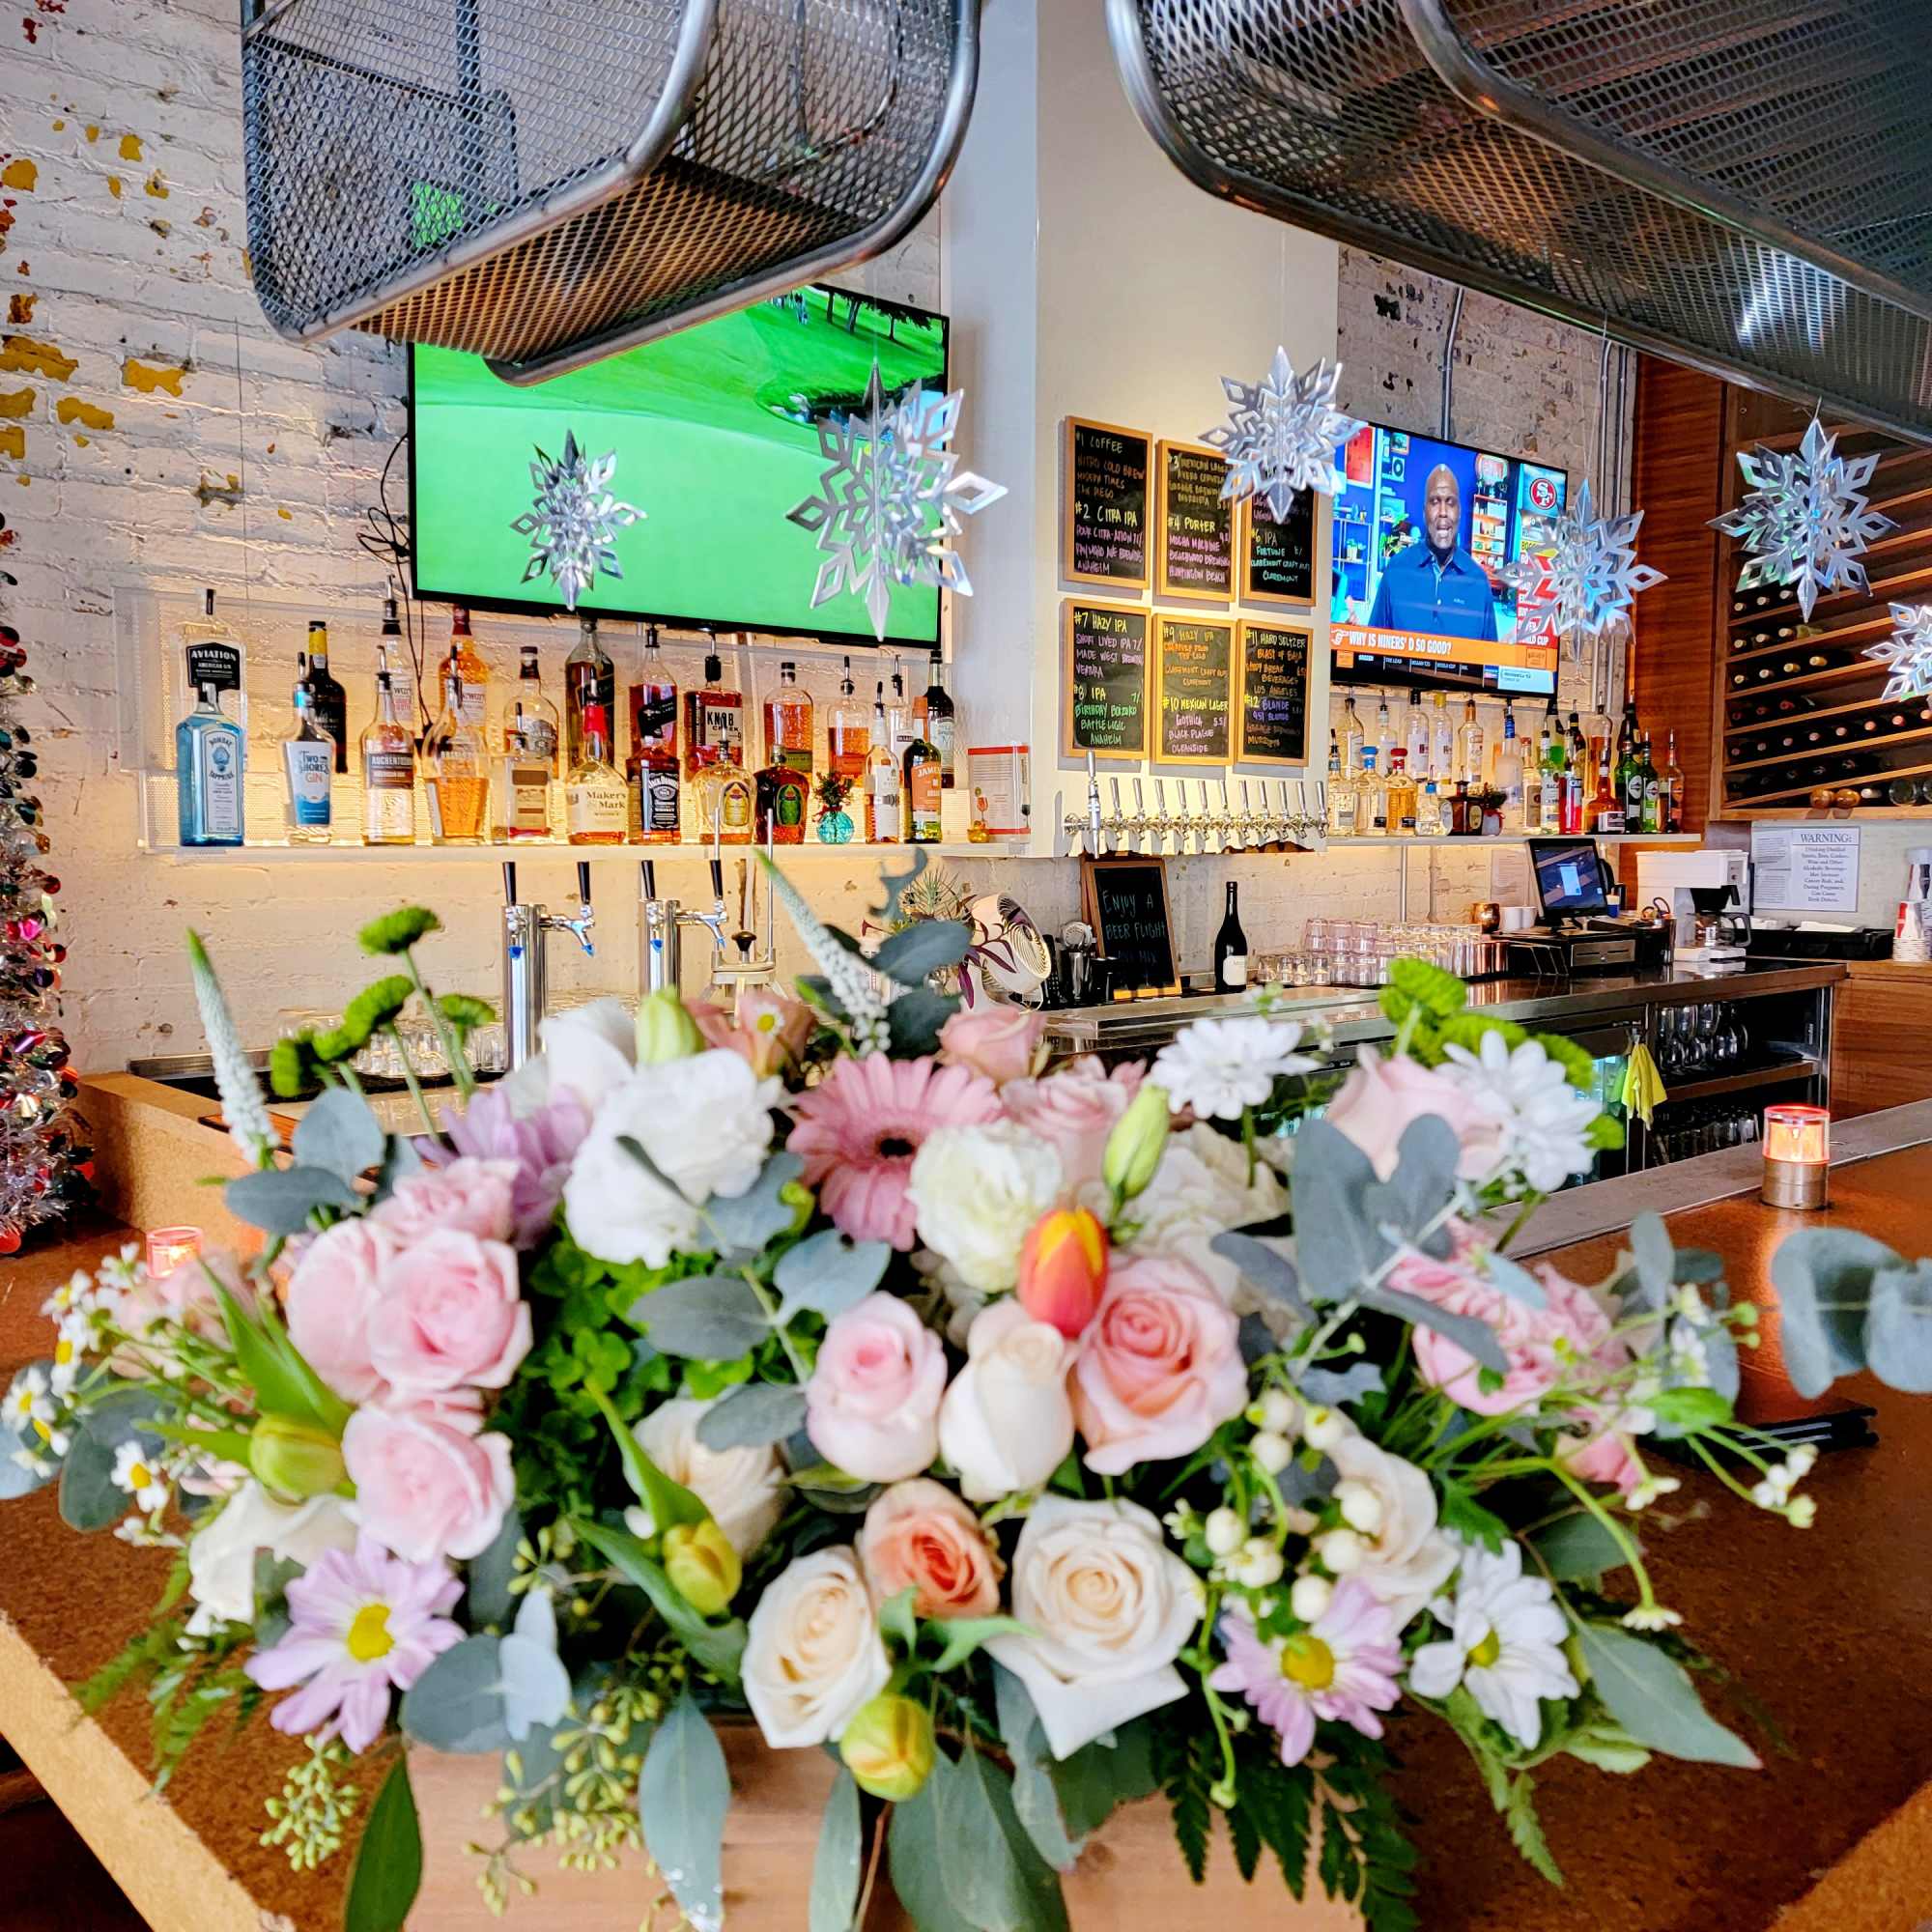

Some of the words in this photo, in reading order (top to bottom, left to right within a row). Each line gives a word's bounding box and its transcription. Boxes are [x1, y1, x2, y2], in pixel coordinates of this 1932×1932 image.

[1091, 438, 1123, 453] COFFEE
[1104, 461, 1121, 474] COLD
[1123, 467, 1144, 479] BREW
[1104, 474, 1124, 490] TIMES
[1075, 501, 1091, 519] #2
[1097, 505, 1122, 523] CITRA
[1124, 510, 1137, 526] IPA
[1185, 517, 1215, 534] PORTER
[1264, 531, 1277, 547] IPA
[1074, 611, 1088, 628] #7
[1093, 614, 1112, 631] HAZY
[1115, 619, 1127, 634] IPA
[1163, 626, 1175, 641] #9
[1179, 629, 1198, 642] HAZY
[1260, 634, 1277, 646] HARD
[1537, 635, 1549, 646] CUP
[1098, 636, 1118, 649] LIVED
[1120, 639, 1131, 650] IPA
[1349, 630, 1368, 646] WHY
[1368, 633, 1377, 647] IS
[1408, 637, 1415, 652] D
[1415, 638, 1426, 653] SO
[1427, 639, 1452, 656] GOOD?
[191, 649, 237, 661] AVIATION
[1076, 648, 1096, 661] MADE
[1100, 651, 1118, 663] WEST
[1257, 649, 1276, 660] BLAST
[1092, 687, 1106, 701] IPA
[1254, 685, 1266, 695] LOS
[1269, 686, 1297, 697] ANGELES
[1162, 696, 1179, 712] #10
[1180, 698, 1207, 711] MEXICAN
[1209, 699, 1229, 712] LAGER
[1244, 695, 1260, 708] #12
[1262, 698, 1290, 710] BLONDE
[707, 711, 734, 726] KNOB
[1168, 729, 1189, 740] BLACK
[1191, 729, 1214, 739] PLAGUE
[1172, 743, 1208, 753] OCEANSIDE
[299, 751, 319, 764] TWO
[305, 773, 323, 783] GIN
[648, 776, 661, 788] JACK
[598, 801, 626, 810] Mark
[1801, 833, 1853, 843] WARNING:
[1103, 890, 1136, 918] ENJOY
[1146, 894, 1154, 909] A
[1106, 923, 1130, 941] BEER
[1134, 922, 1166, 941] FLIGHT
